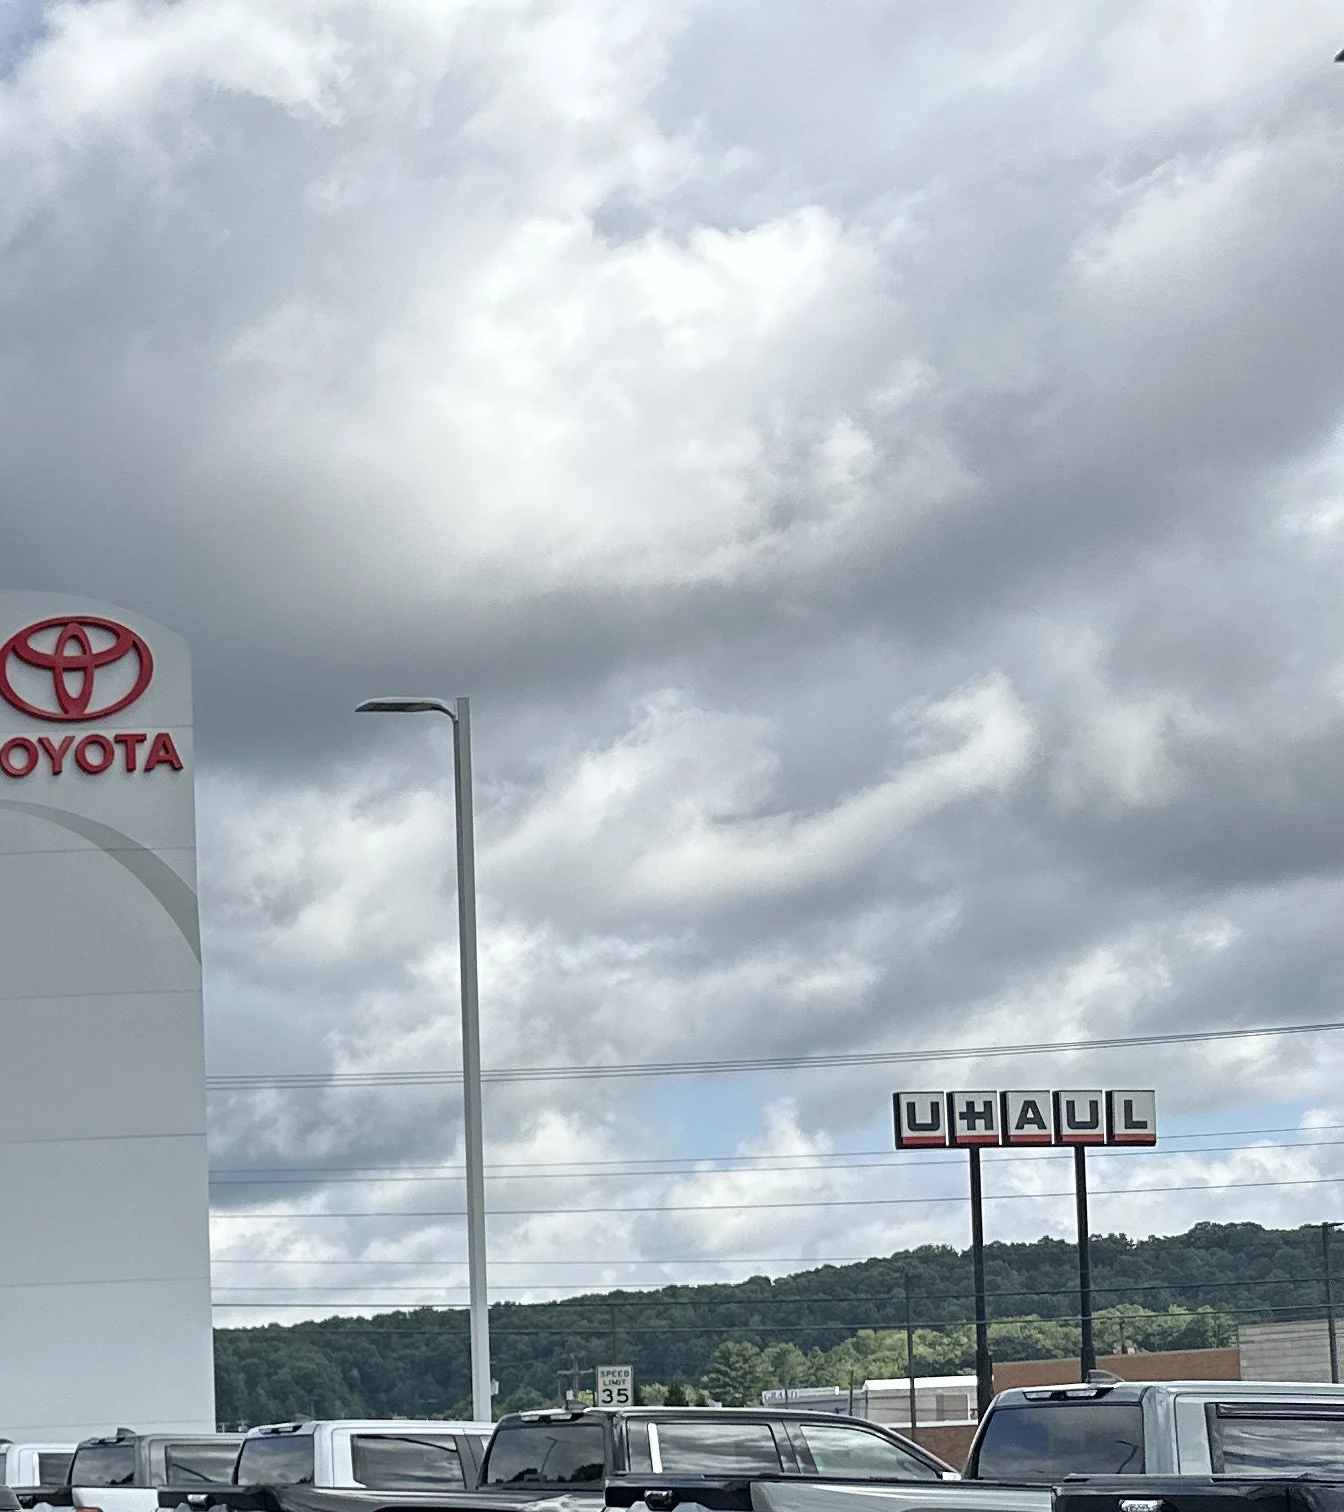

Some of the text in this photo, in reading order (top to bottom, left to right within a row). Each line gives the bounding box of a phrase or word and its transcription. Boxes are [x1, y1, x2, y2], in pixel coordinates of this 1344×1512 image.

[600, 1370, 630, 1378] SPEED
[603, 1379, 627, 1387] LIMIT
[602, 1388, 629, 1404] 35
